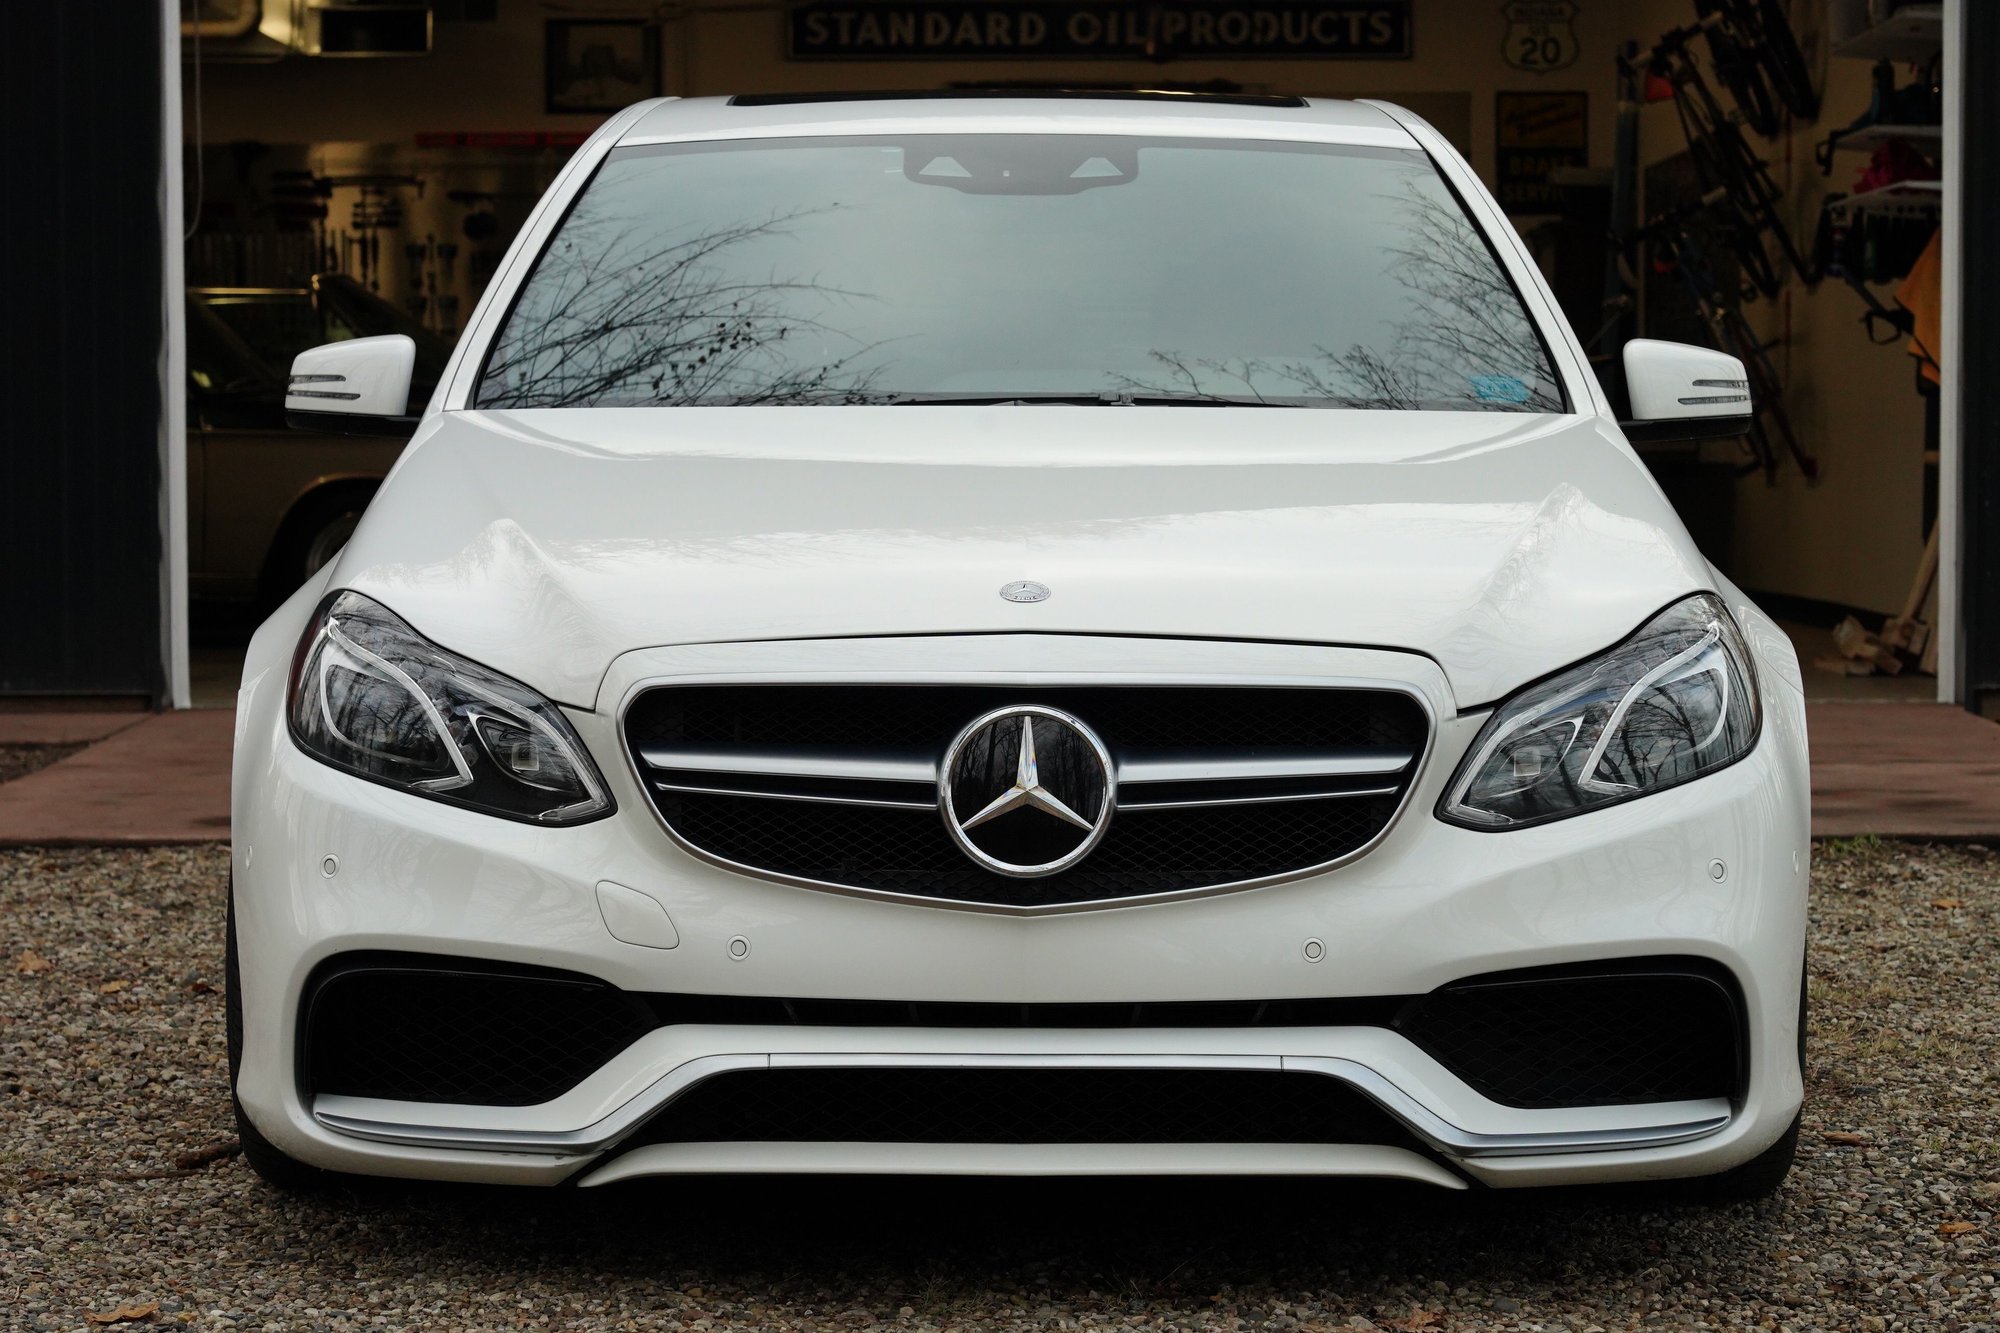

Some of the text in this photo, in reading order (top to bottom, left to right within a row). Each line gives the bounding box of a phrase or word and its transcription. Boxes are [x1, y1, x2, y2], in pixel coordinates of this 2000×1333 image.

[804, 10, 1393, 46] STANDARD OIL PRODUCTS
[1520, 37, 1561, 64] 20
